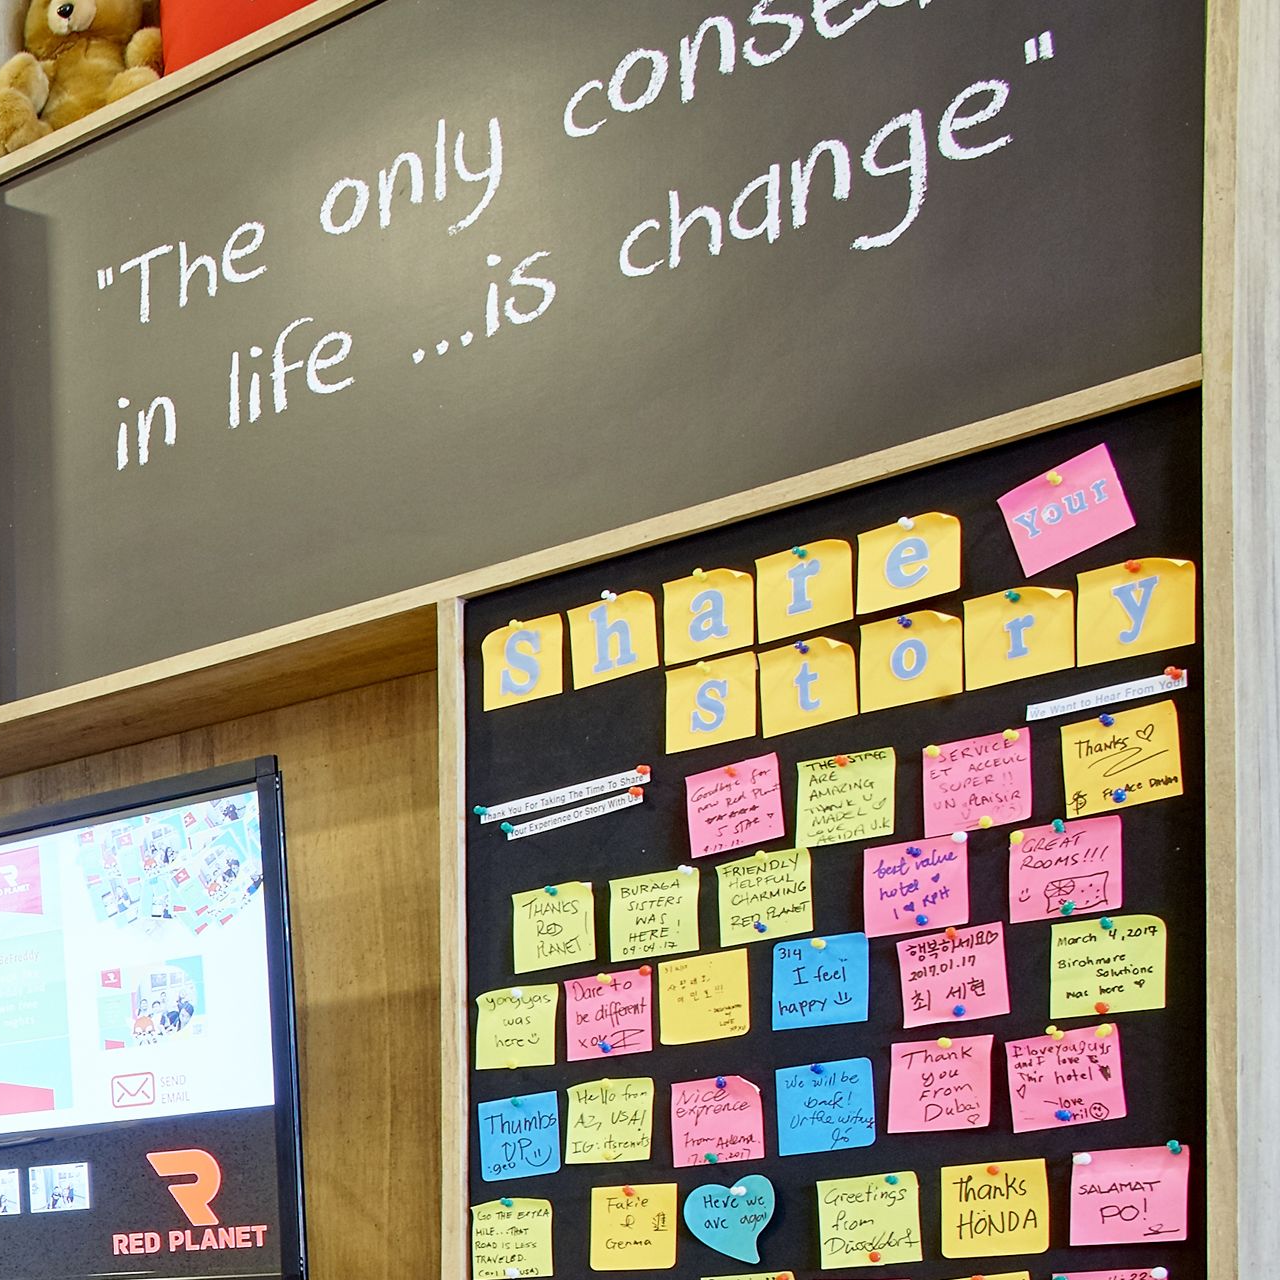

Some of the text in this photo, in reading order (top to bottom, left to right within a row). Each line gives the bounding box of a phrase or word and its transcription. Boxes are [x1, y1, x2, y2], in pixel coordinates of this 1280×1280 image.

[95, 215, 268, 325] "The
[318, 116, 505, 237] only
[115, 392, 179, 472] in
[226, 315, 357, 429] life
[1013, 479, 1109, 538] Your
[1031, 709, 1046, 718] We
[1050, 702, 1077, 714] Want
[1080, 698, 1091, 707] to
[1095, 692, 1121, 703] Hear
[1125, 686, 1154, 696] From
[1075, 732, 1129, 759] Thanks
[508, 806, 522, 814] You
[525, 801, 538, 811] For
[541, 795, 566, 807] Taking
[569, 790, 583, 799] The
[586, 784, 605, 794] Time
[608, 781, 617, 789] To
[621, 775, 644, 786] Share
[510, 827, 527, 837] Your
[529, 814, 572, 832] Experience
[585, 803, 606, 815] Story
[608, 797, 627, 808] With
[1021, 831, 1086, 853] GREAT
[723, 854, 799, 878] FRIENDLY
[914, 850, 958, 872] value
[729, 874, 794, 888] HELPFUL
[731, 881, 807, 906] CHARMING
[522, 897, 579, 918] THANKS
[636, 913, 665, 925] WAS
[906, 933, 988, 964] 행복하세요
[1058, 933, 1097, 947] March
[780, 948, 802, 960] 314
[793, 966, 847, 985] I feel
[572, 979, 632, 1001] Dare to
[575, 1001, 646, 1026] be different
[779, 998, 827, 1017] happy
[901, 1045, 972, 1071] Thank
[841, 1072, 859, 1084] be
[922, 1070, 959, 1088] you
[576, 1088, 616, 1103] Hello
[925, 1102, 980, 1122] Dubai
[484, 1112, 556, 1136] Thumbs
[1078, 1181, 1161, 1195] SALAMAT
[746, 1196, 766, 1207] we
[1100, 1198, 1148, 1224] PO!
[113, 1225, 267, 1255] RED PLANET
